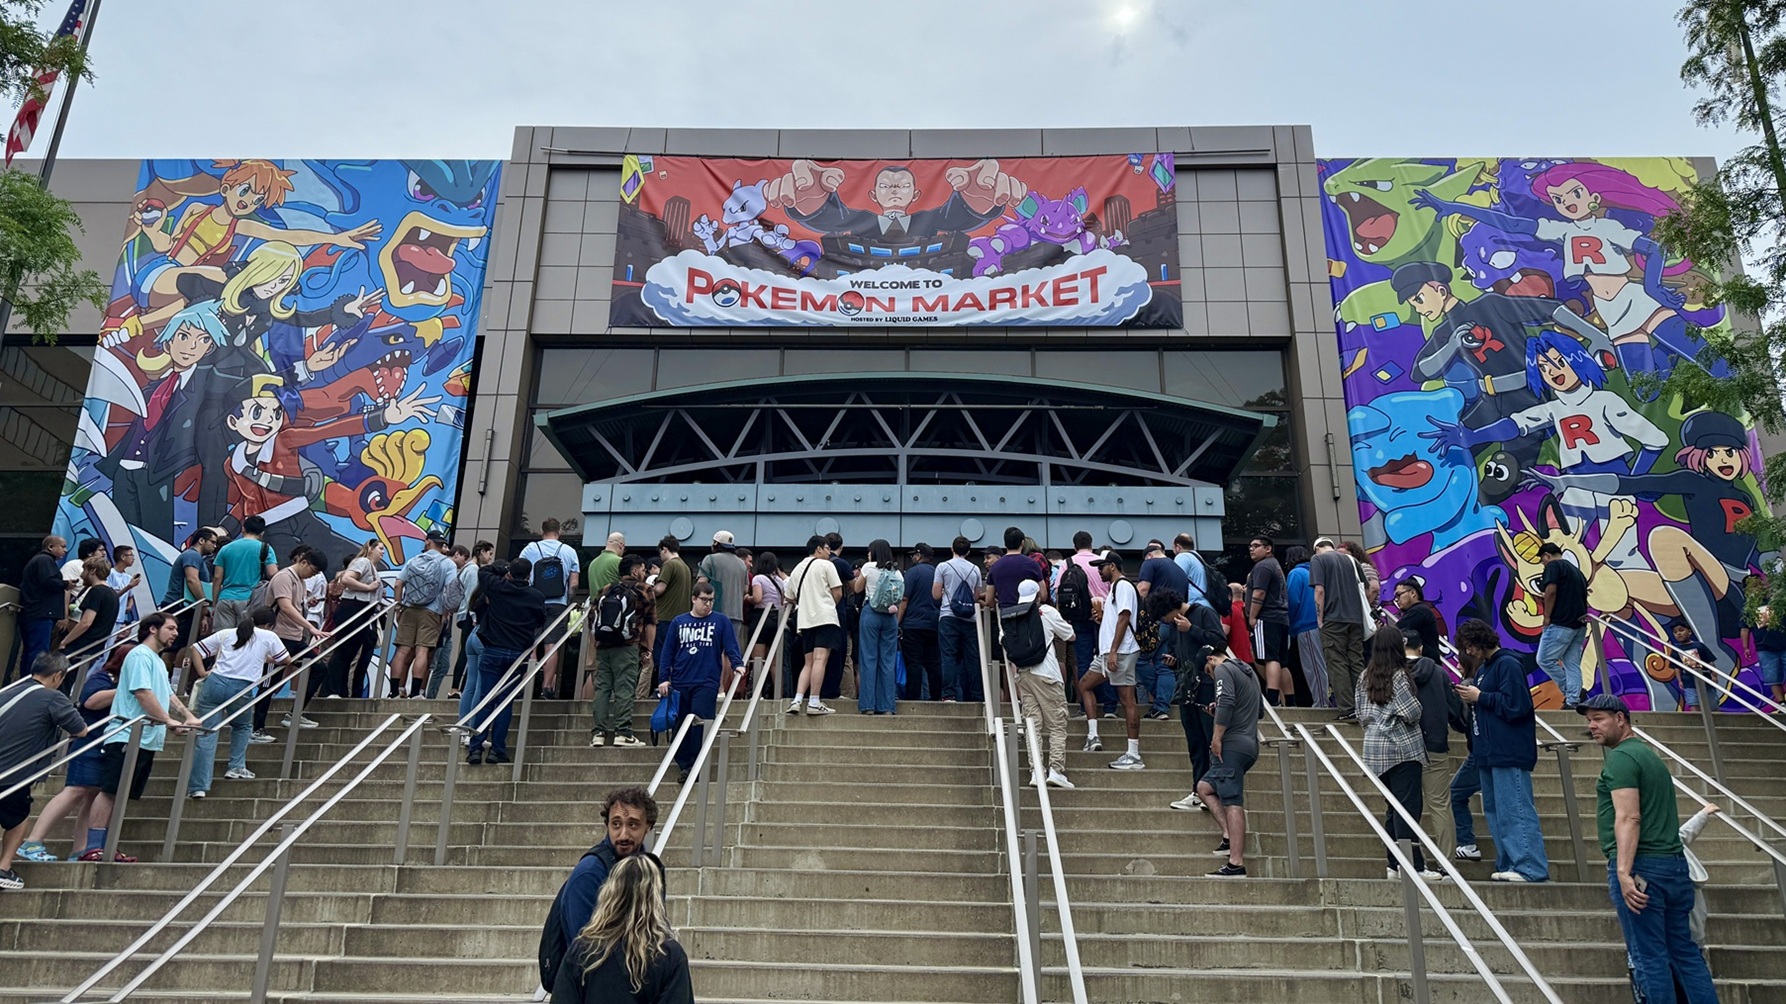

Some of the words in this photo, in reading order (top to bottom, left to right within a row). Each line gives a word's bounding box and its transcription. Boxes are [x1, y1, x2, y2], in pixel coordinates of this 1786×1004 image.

[1571, 235, 1607, 265] R
[850, 280, 920, 290] WELCOME
[923, 279, 943, 289] TO
[911, 265, 1108, 313] MARKET
[885, 315, 911, 323] LIQUID
[912, 315, 938, 323] GAMES
[1559, 413, 1601, 450] R
[679, 625, 715, 644] UNCLE
